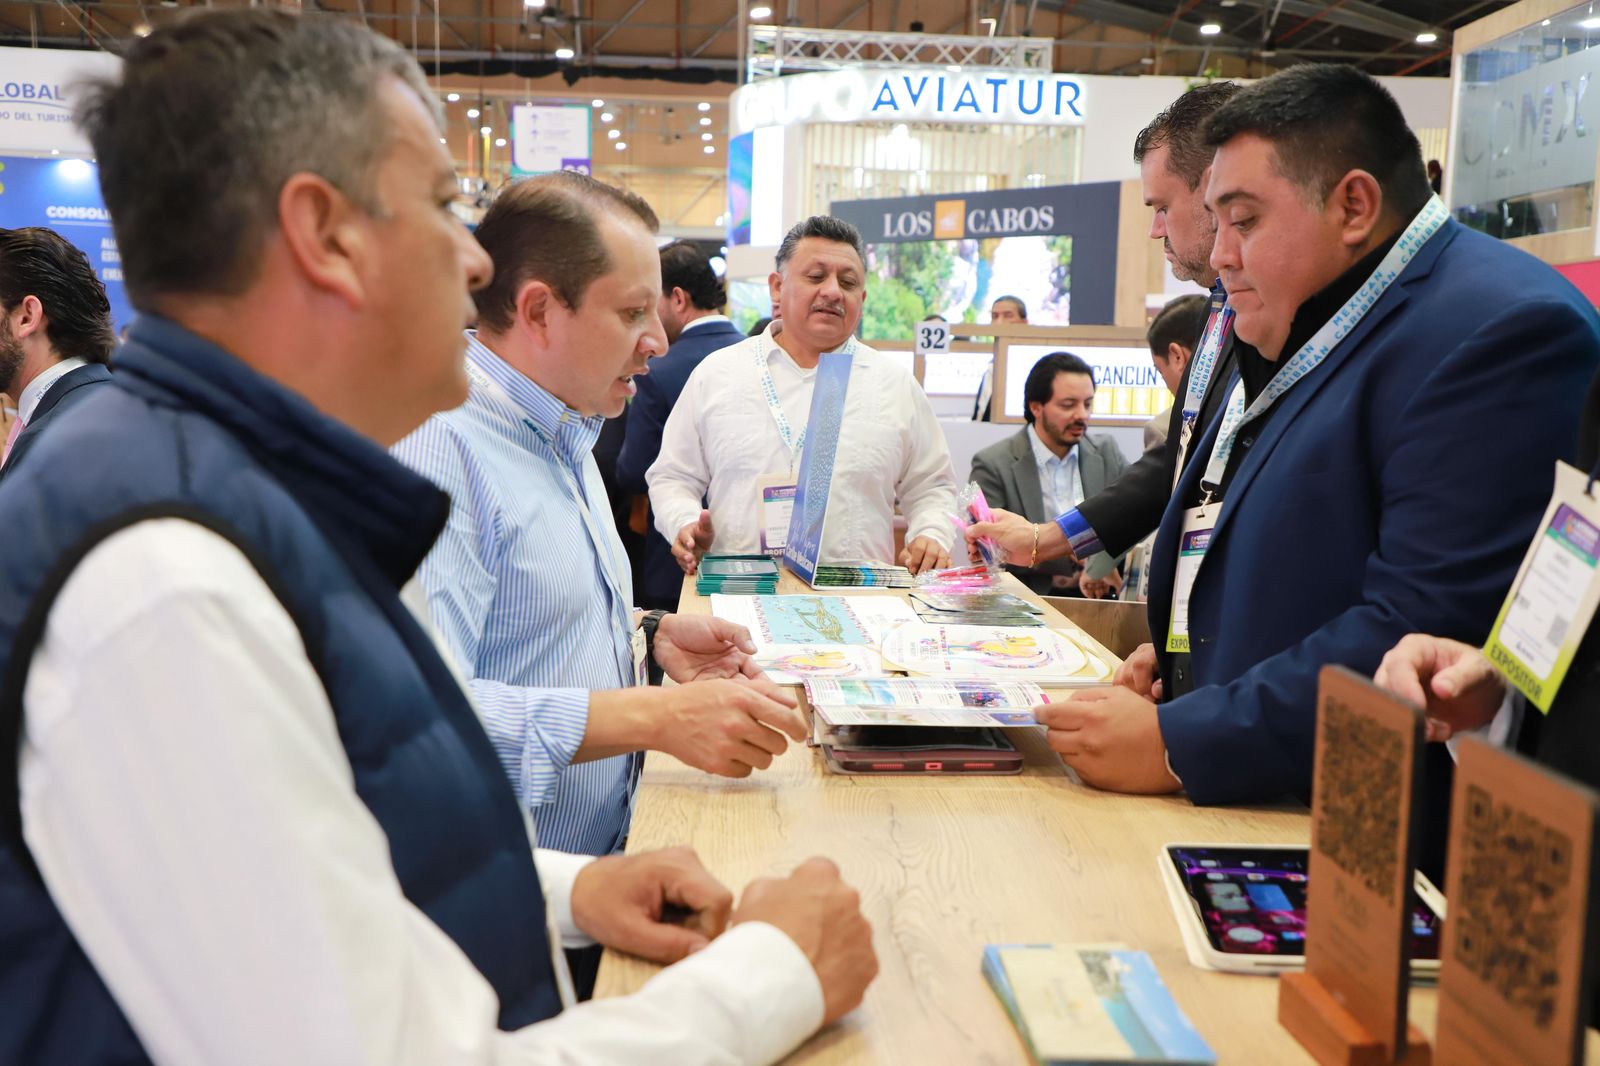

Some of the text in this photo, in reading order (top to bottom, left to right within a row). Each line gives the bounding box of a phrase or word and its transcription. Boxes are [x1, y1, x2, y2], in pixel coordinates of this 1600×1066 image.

[14, 112, 33, 122] DEL
[37, 113, 80, 123] TURISM
[872, 76, 1082, 117] AVIATUR
[882, 205, 1055, 238] LOS CABOS
[1398, 203, 1437, 250] MEXICAN
[1332, 271, 1382, 326] MEXICAN
[1334, 271, 1396, 340] CARIBBEAN
[920, 327, 945, 349] 32
[1091, 365, 1158, 386] CANCUN
[1190, 353, 1207, 393] MEXICAN
[1196, 351, 1215, 400] CARIBBEAN
[1267, 344, 1315, 391] MEXICAN
[1269, 345, 1329, 400] CARIBBEAN
[1490, 644, 1543, 701] EXPOSITOR
